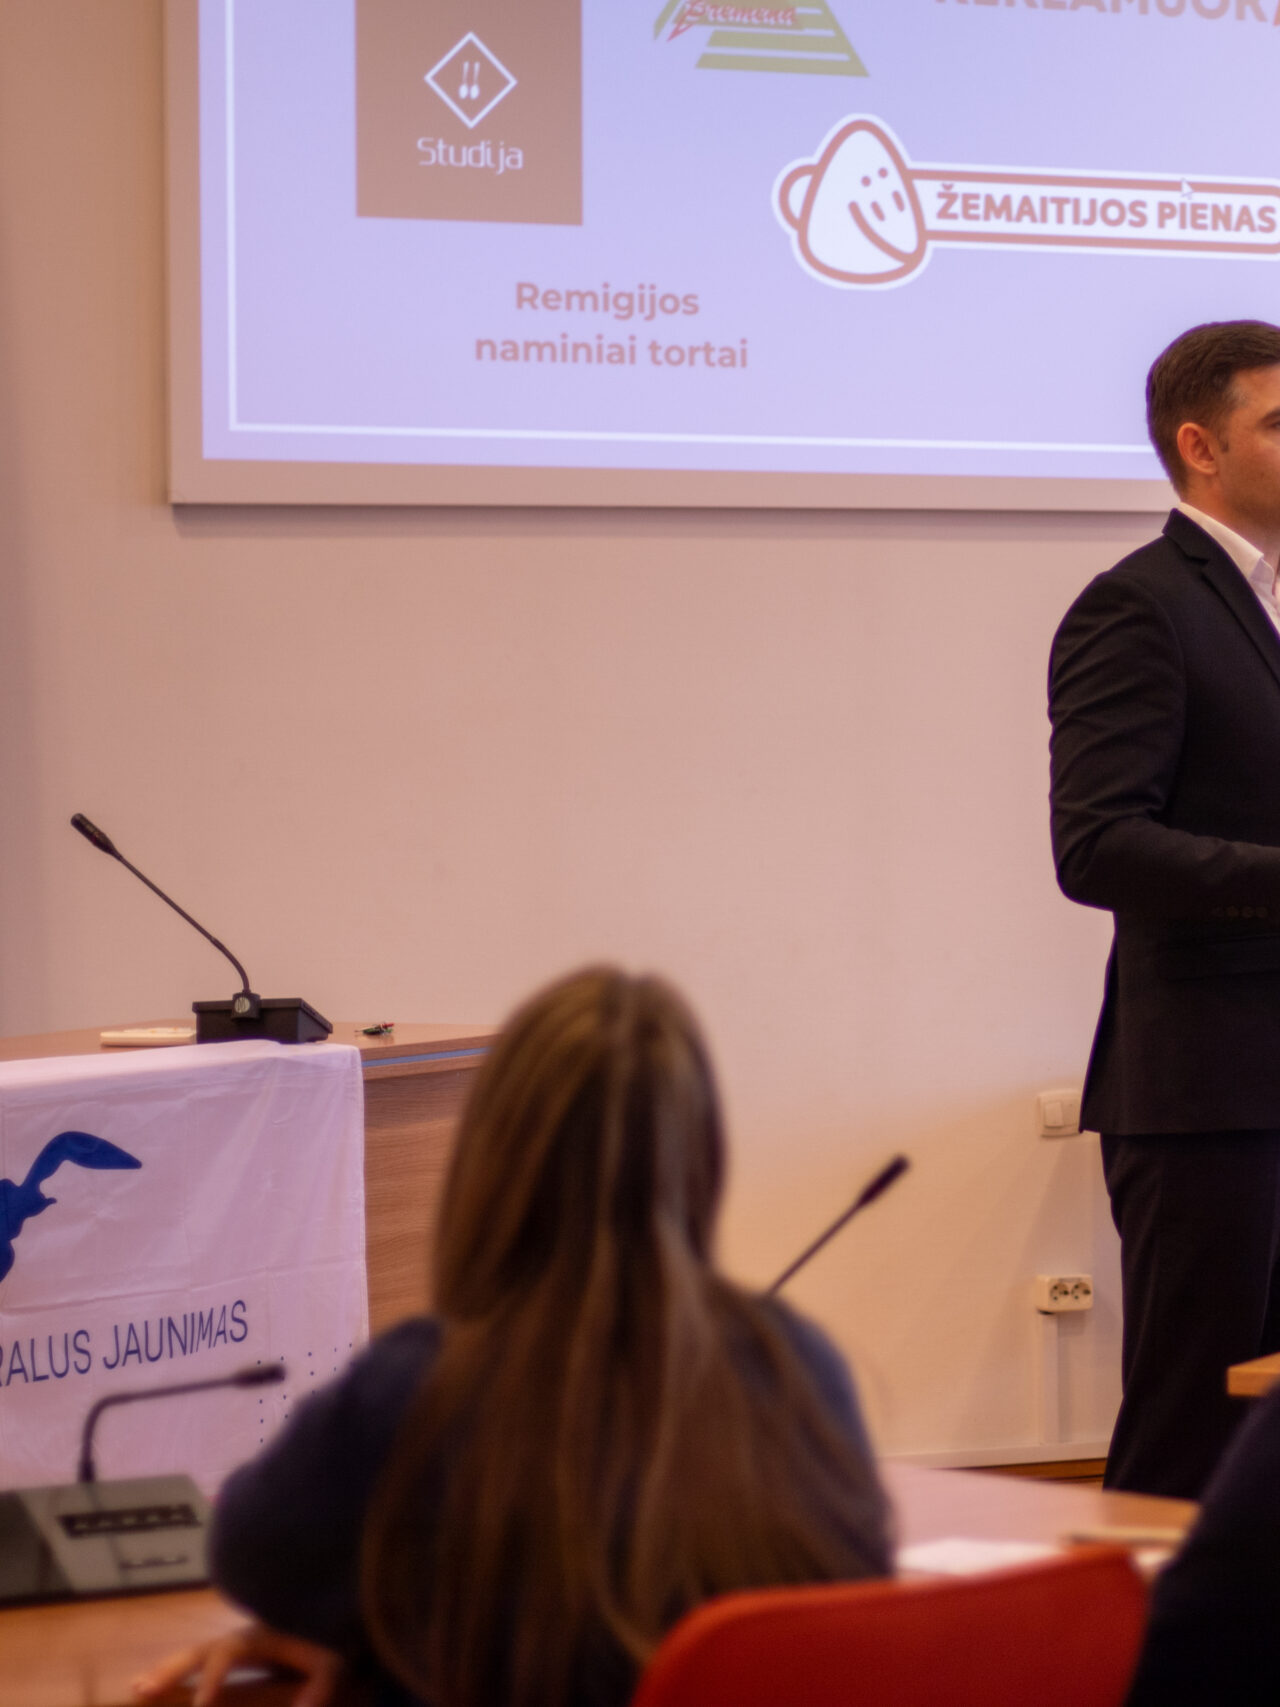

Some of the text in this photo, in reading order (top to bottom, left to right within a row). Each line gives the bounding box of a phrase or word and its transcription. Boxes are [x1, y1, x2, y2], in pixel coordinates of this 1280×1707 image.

[416, 137, 524, 175] Studija
[936, 183, 1277, 234] ŽEMAITIJOS PIENAS
[515, 281, 700, 321] Remigijos
[474, 332, 748, 369] naminiai tortai
[103, 1299, 248, 1369] JAUNIMAS
